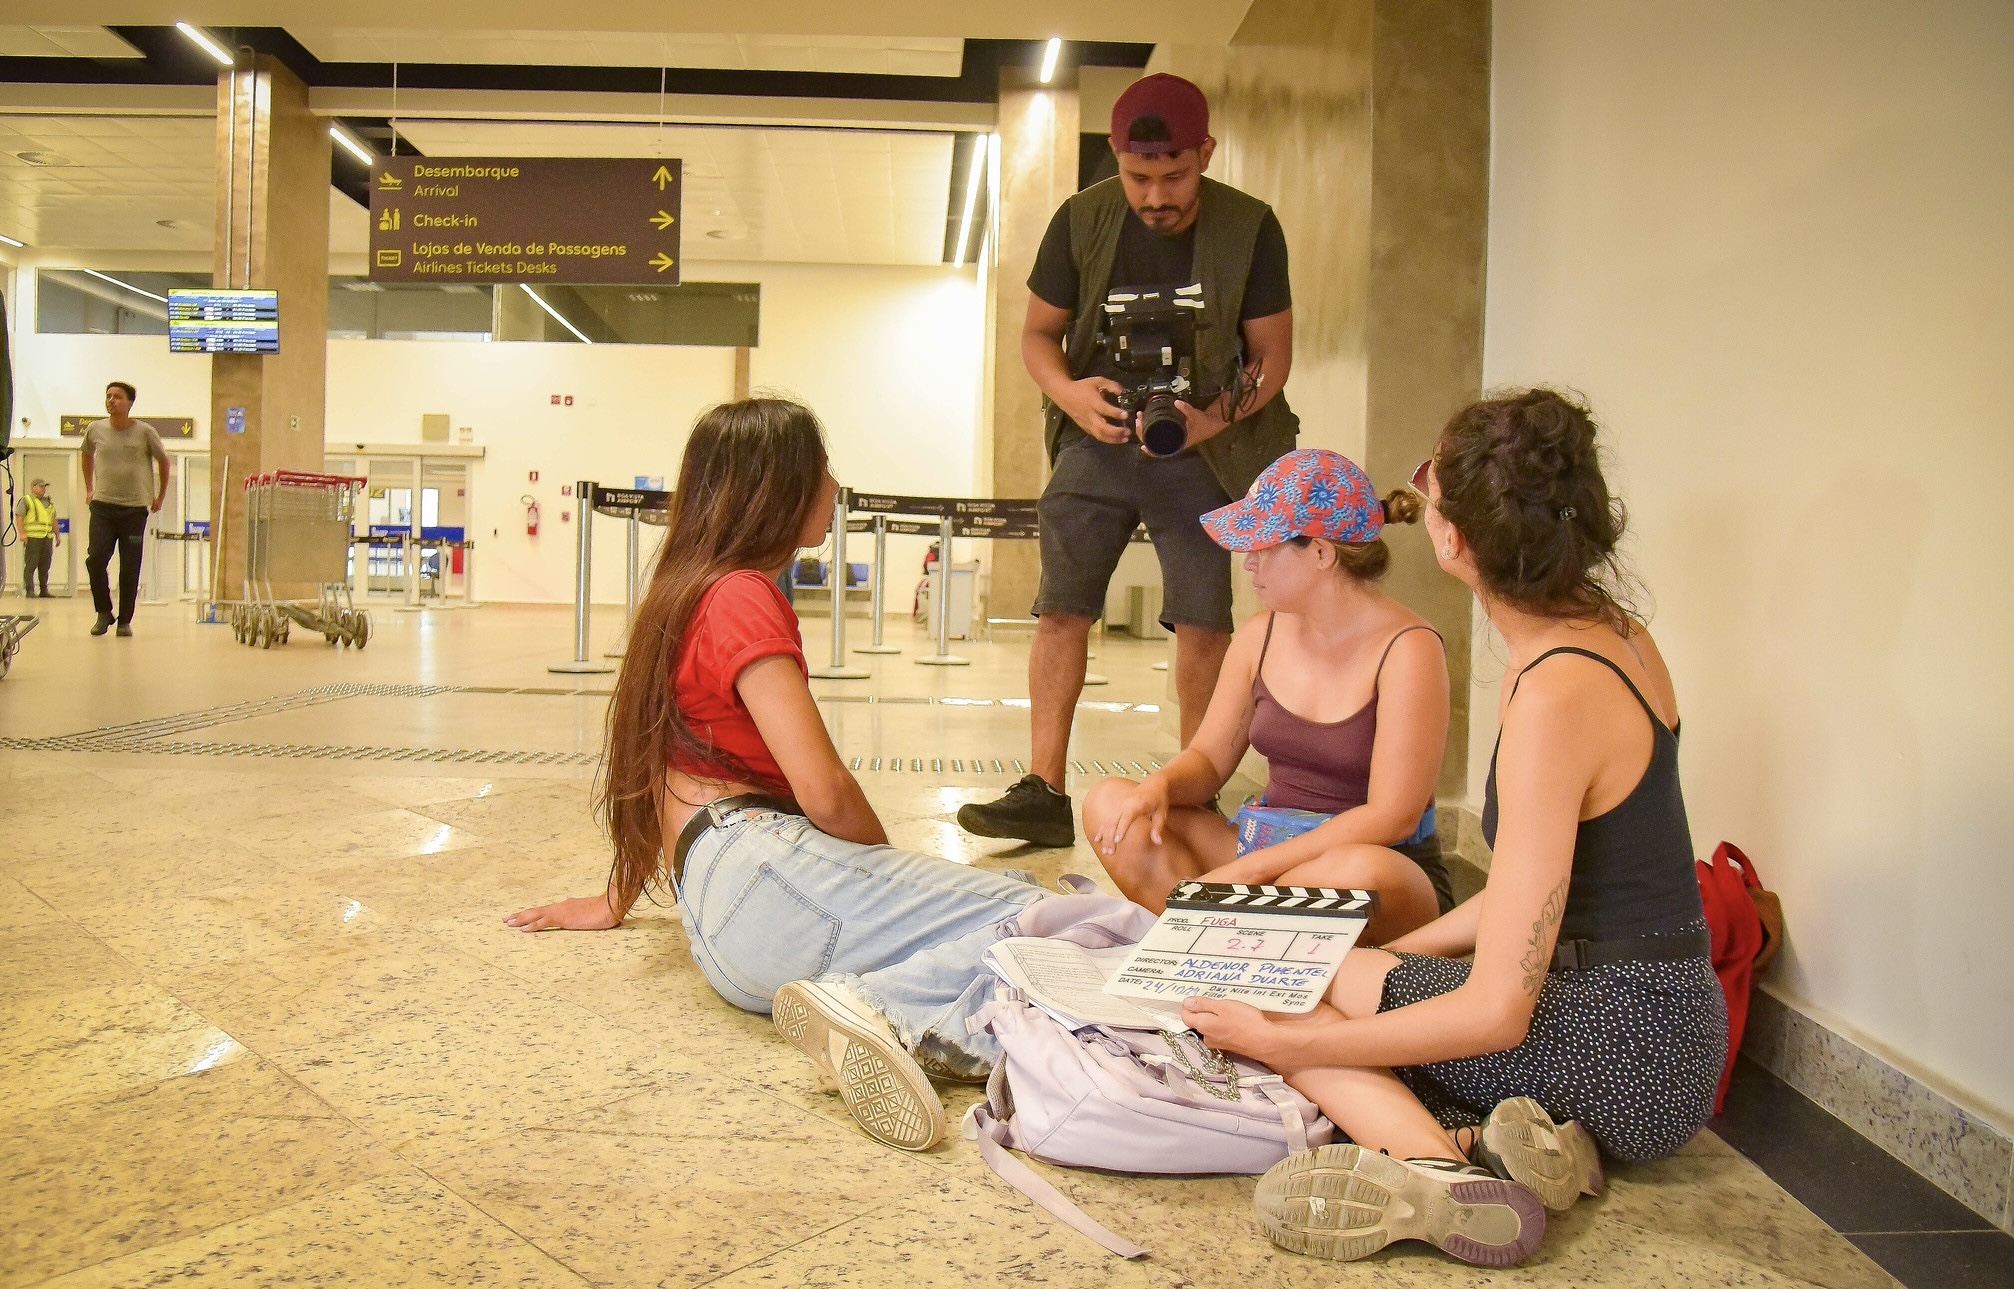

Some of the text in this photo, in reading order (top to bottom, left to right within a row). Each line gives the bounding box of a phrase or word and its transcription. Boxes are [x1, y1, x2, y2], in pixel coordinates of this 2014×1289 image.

[413, 164, 520, 181] Desembarque
[413, 184, 459, 197] Arrival
[413, 213, 478, 227] Check-in
[412, 242, 627, 259] Lojas de Venda de Passagens
[412, 260, 558, 274] Airlines Tickets Desks
[1200, 916, 1237, 927] FUGA
[1237, 929, 1266, 937] SCENE
[1134, 956, 1178, 967] DIRECTOR:
[1181, 958, 1329, 978] ALDENOR PIMENTEL
[1127, 966, 1164, 975] CAMERA:
[1118, 977, 1143, 986] DATE:
[1174, 969, 1309, 987] ADRIANA DUARTE
[1202, 991, 1228, 999] Filter
[1209, 986, 1228, 994] Day
[1230, 987, 1250, 995] Nite
[1288, 992, 1309, 1000] Mos
[1282, 999, 1306, 1007] Sync
